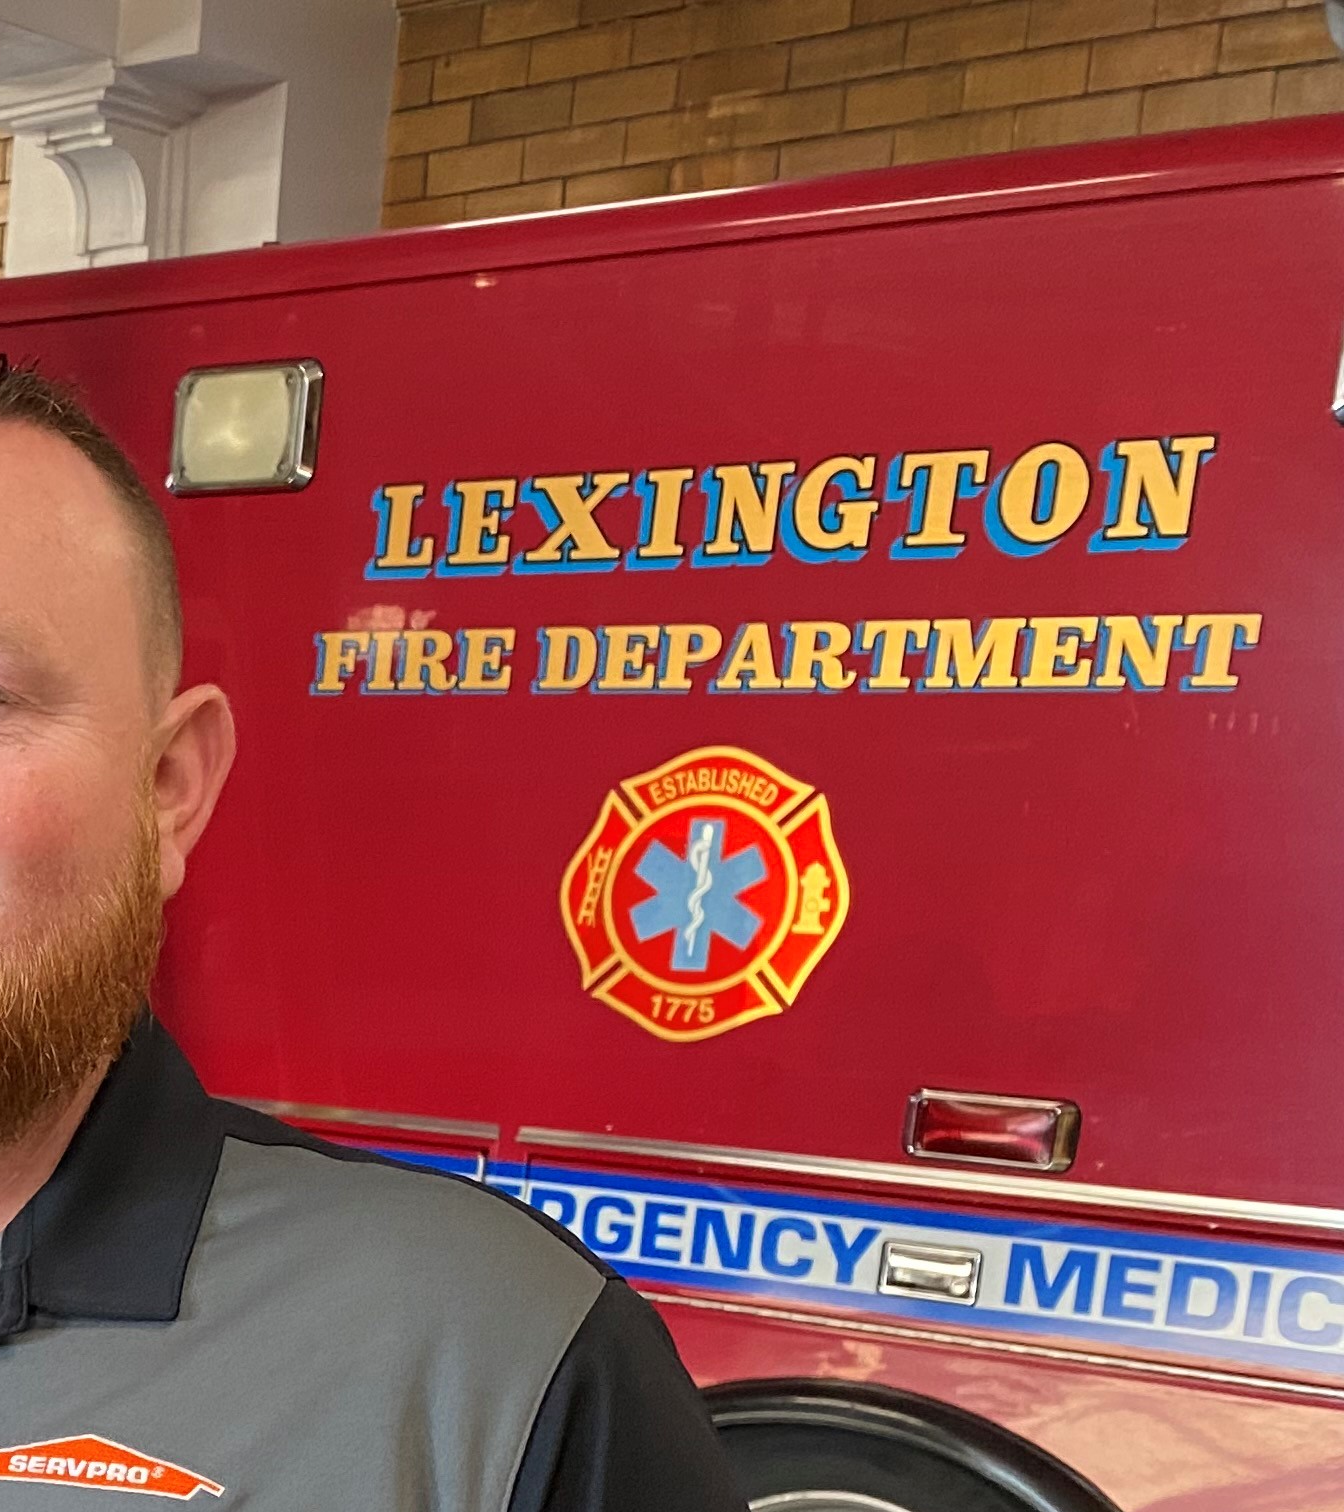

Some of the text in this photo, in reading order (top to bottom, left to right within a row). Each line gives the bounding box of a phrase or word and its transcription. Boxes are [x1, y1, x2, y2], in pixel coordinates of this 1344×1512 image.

[364, 435, 1216, 579] LEXINGTON
[310, 613, 1262, 694] FIRE DEPARTMENT
[649, 768, 779, 807] ESTABLISHED
[650, 994, 716, 1023] 1775
[1004, 1243, 1344, 1347] MEDIC
